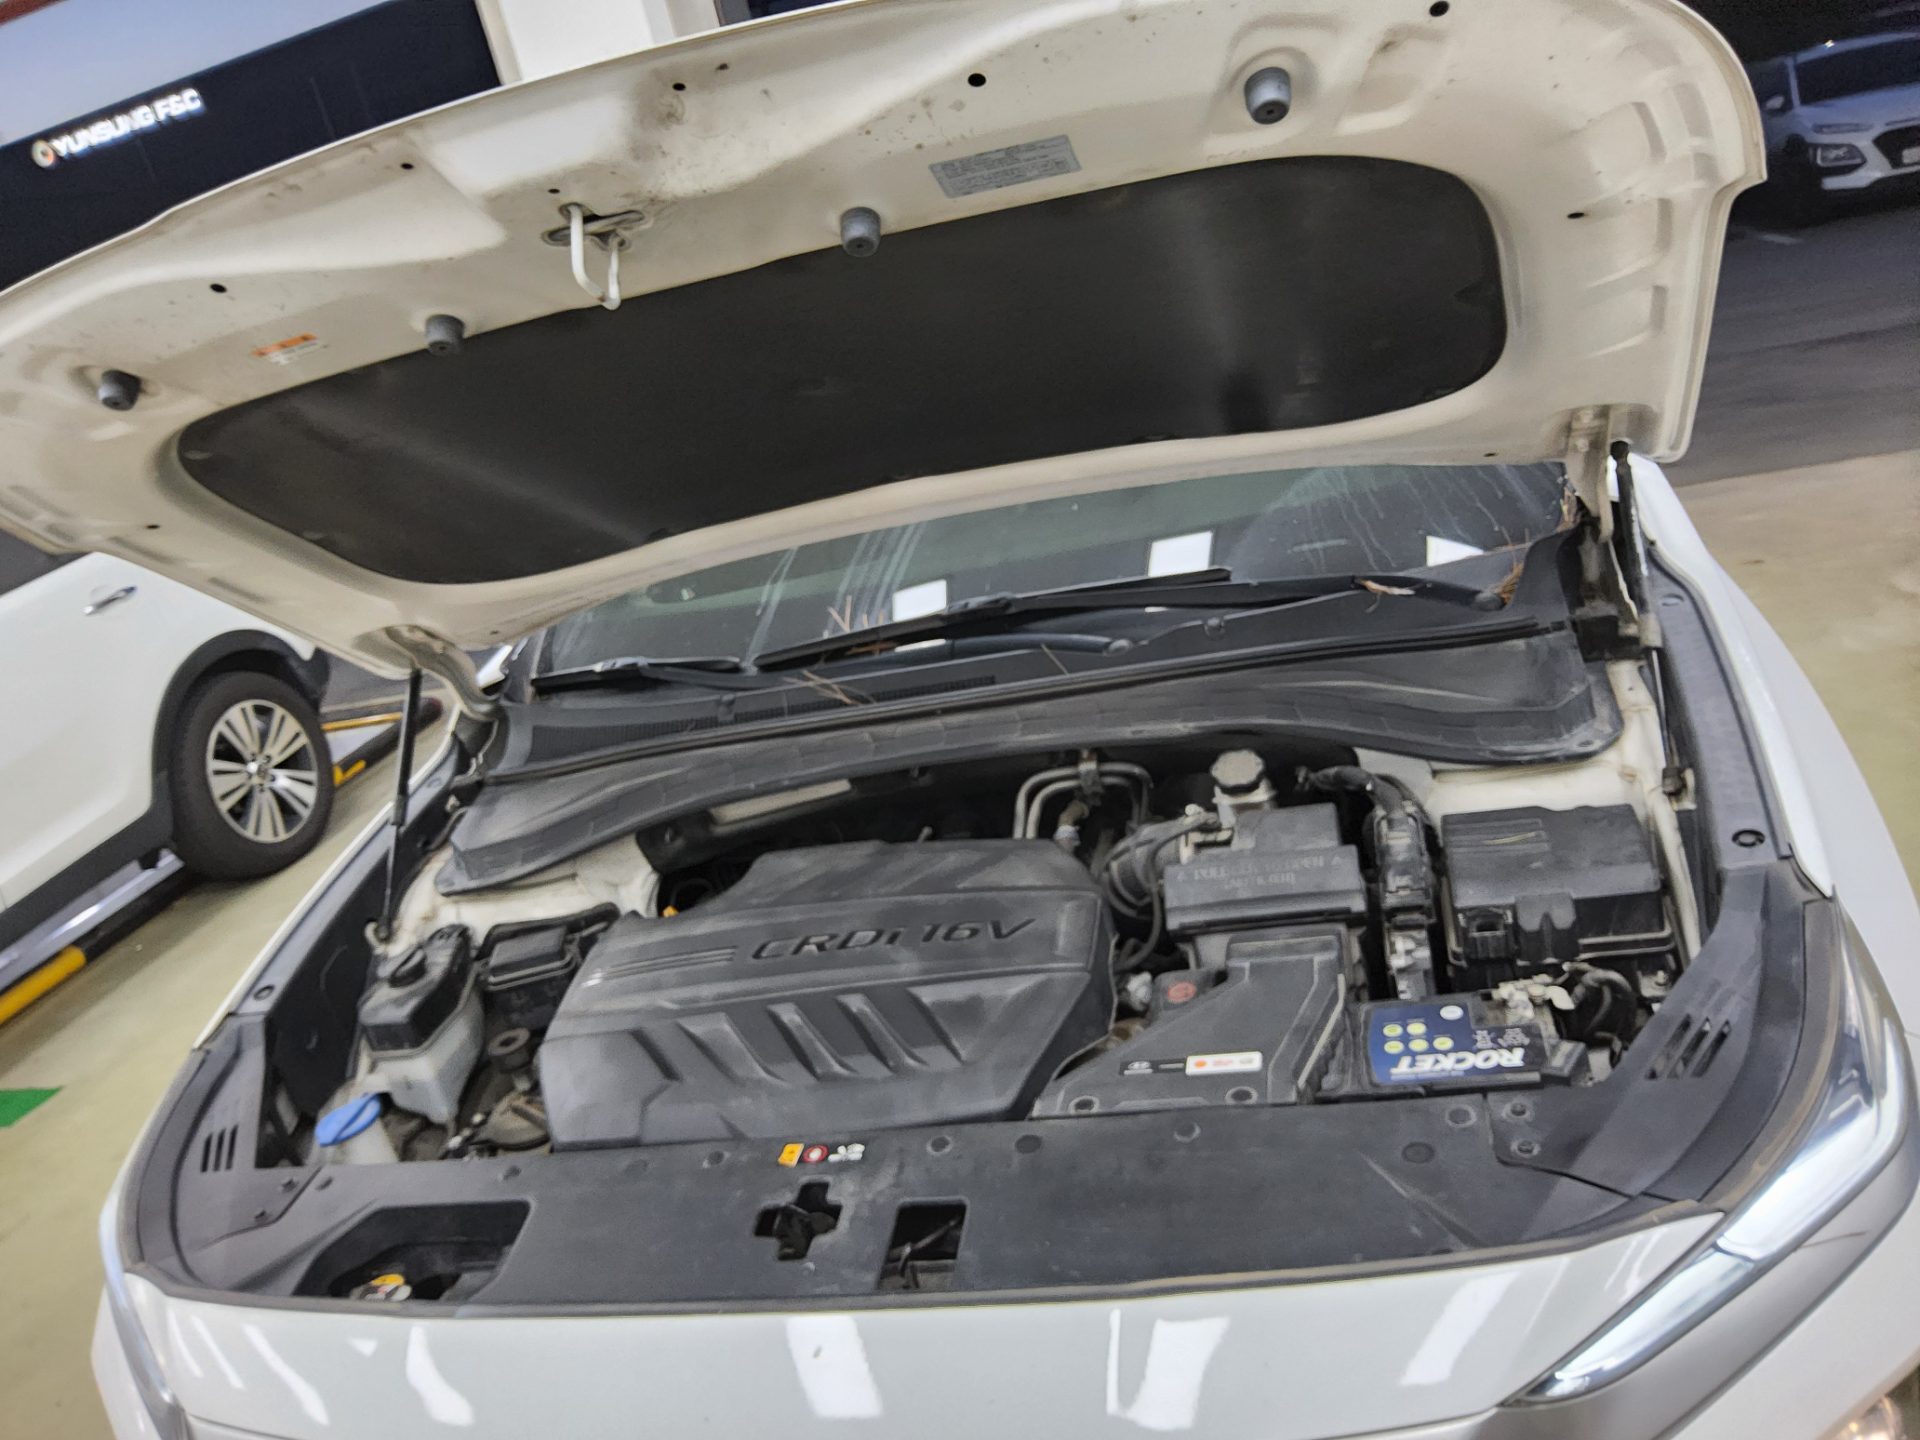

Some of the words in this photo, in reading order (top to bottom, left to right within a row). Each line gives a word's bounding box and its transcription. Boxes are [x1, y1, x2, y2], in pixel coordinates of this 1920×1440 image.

[51, 105, 155, 157] YUNSUNG
[921, 918, 1036, 943] 16V
[1390, 1047, 1525, 1075] ROCKET
